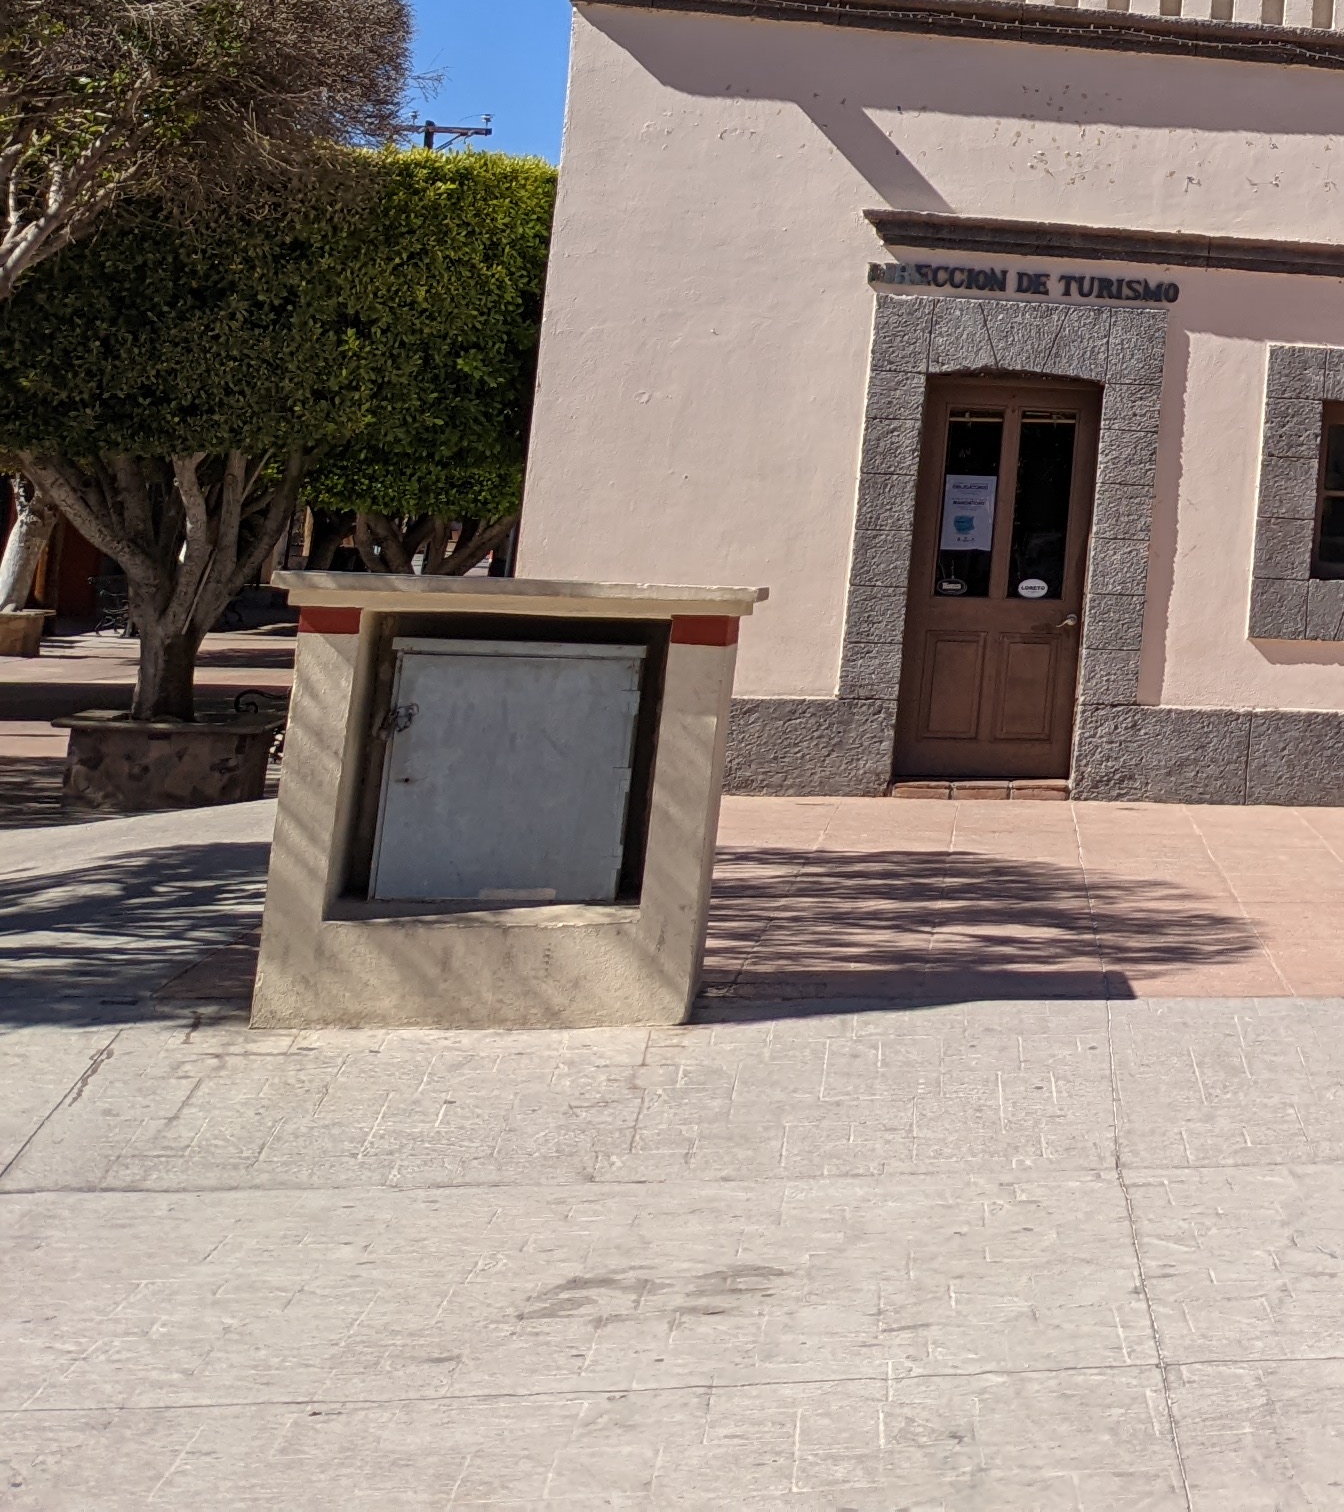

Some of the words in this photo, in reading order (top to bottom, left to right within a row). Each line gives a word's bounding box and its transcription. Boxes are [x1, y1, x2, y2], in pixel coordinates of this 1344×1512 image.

[868, 262, 1009, 293] DIRECCION
[1016, 271, 1050, 296] DE
[1058, 274, 1180, 304] TURISMO
